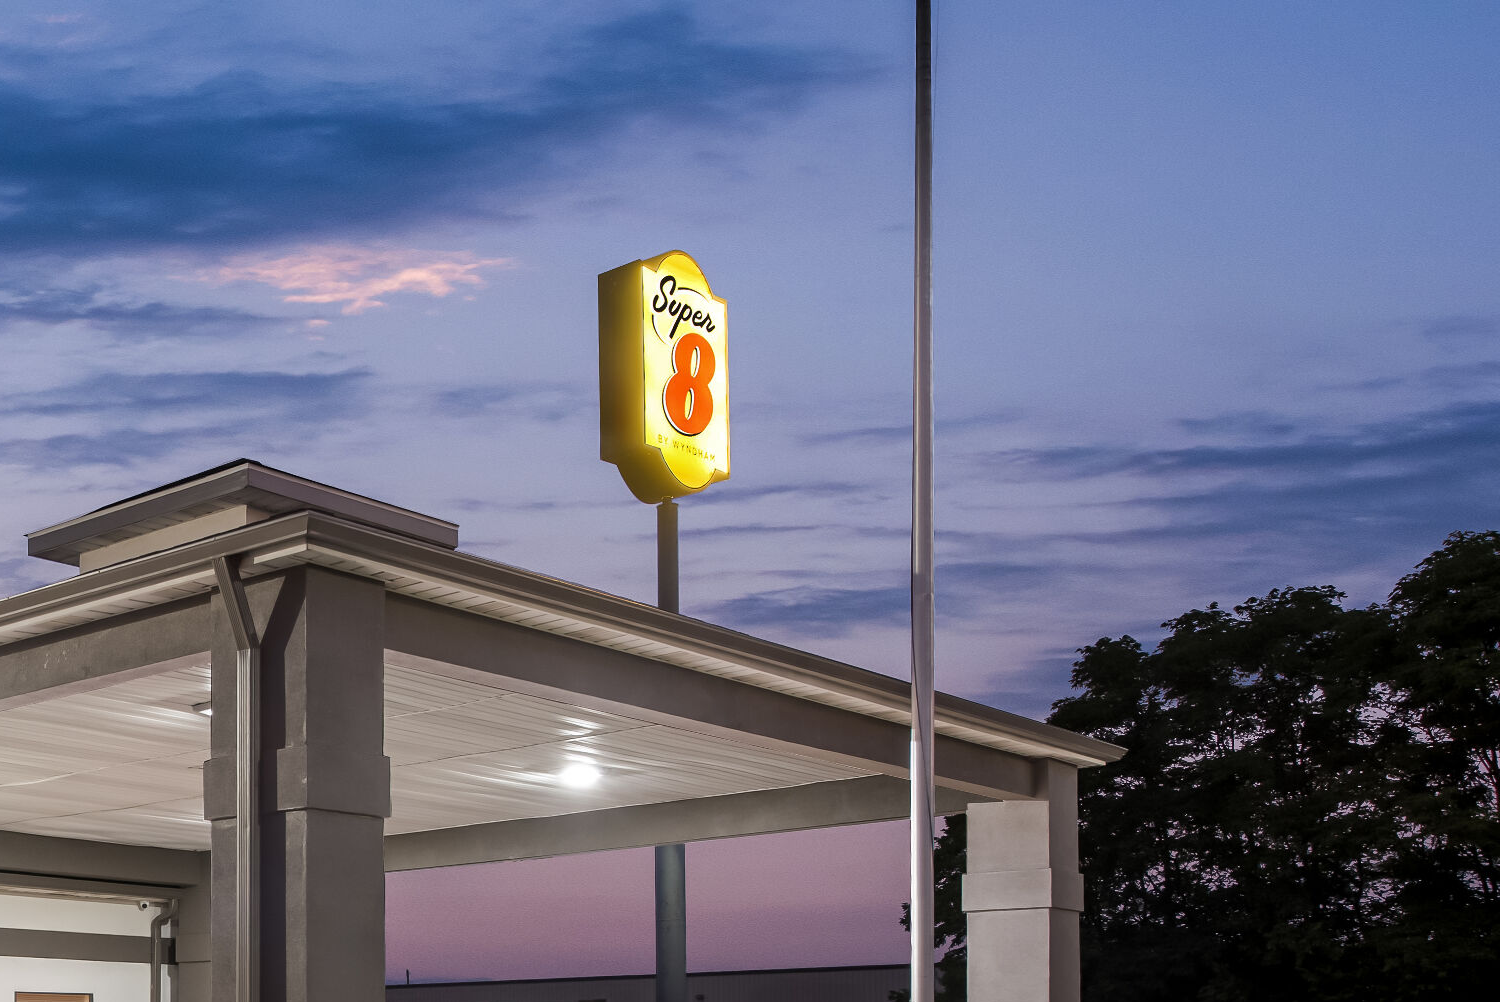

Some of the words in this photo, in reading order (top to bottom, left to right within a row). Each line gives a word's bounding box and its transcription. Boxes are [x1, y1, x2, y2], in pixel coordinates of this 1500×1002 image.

[653, 275, 716, 339] Super
[663, 332, 716, 437] 8
[658, 433, 669, 444] BY
[673, 440, 716, 462] WYNDHAM
